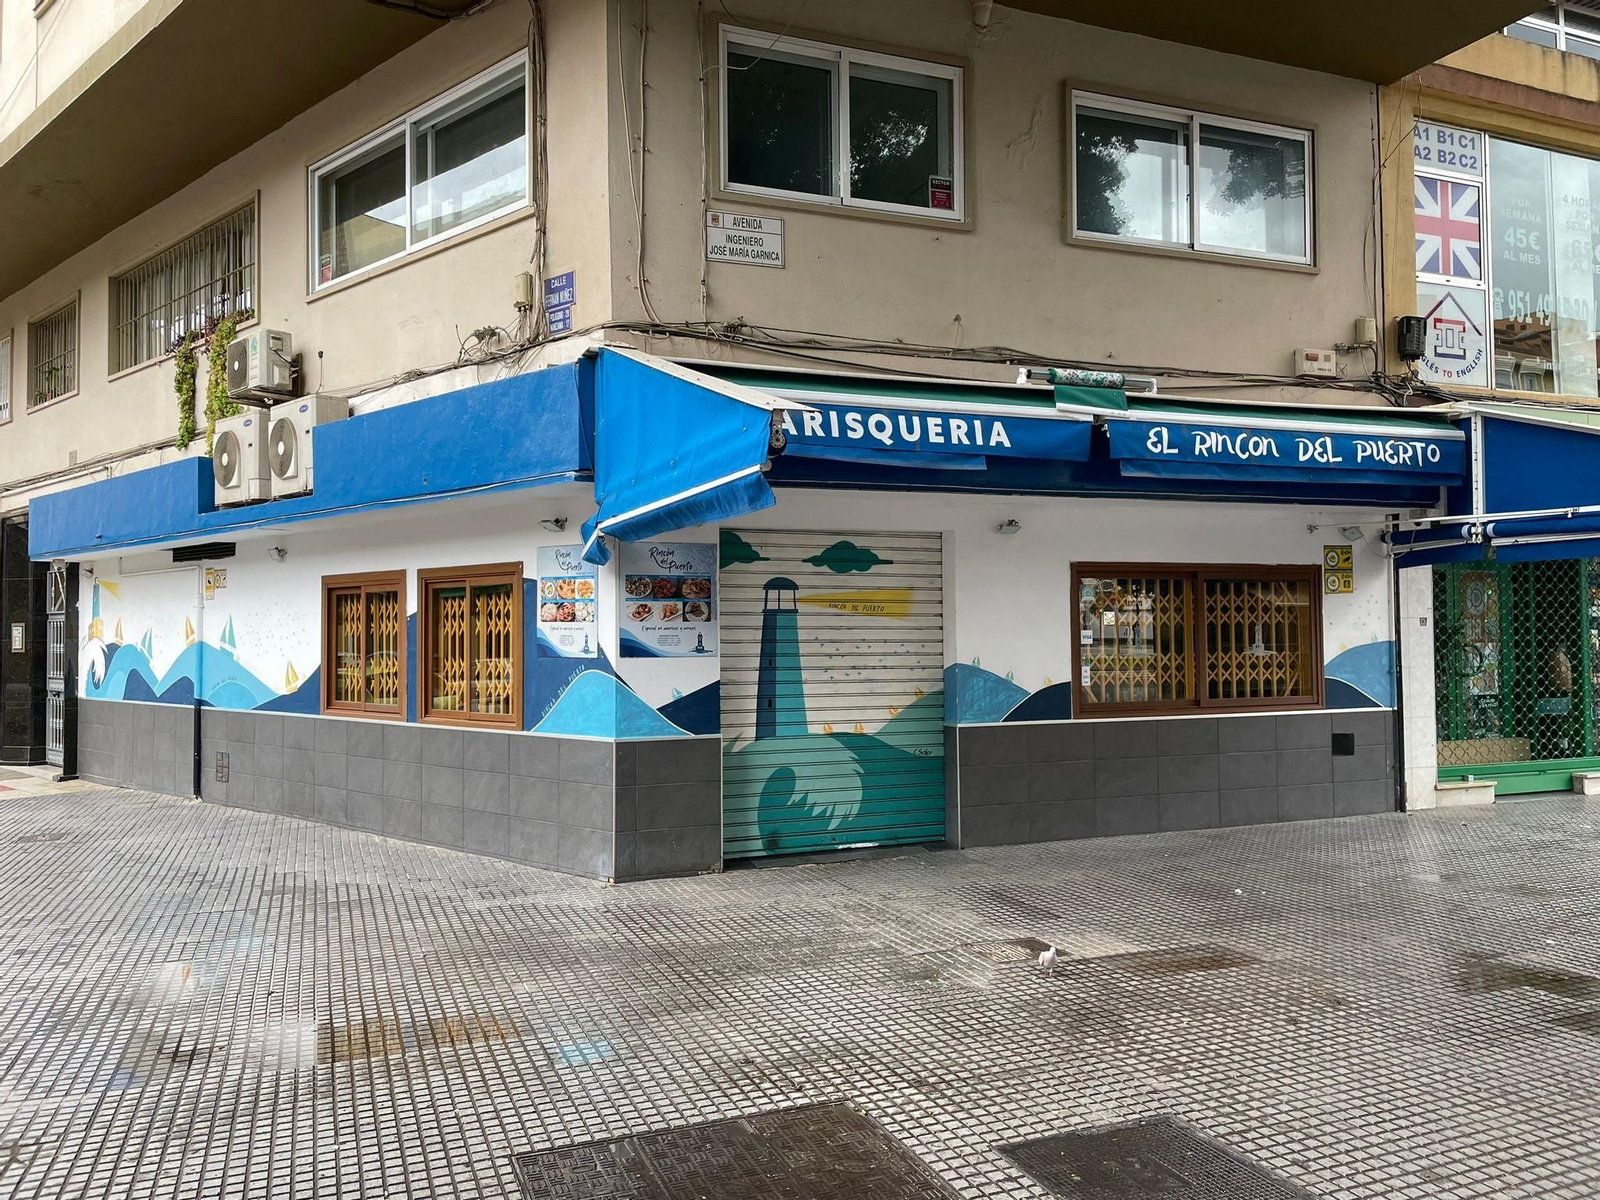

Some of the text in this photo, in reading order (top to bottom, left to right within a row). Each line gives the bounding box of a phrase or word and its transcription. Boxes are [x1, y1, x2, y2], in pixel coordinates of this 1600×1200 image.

[1414, 126, 1475, 150] A1 B1 C1
[1414, 145, 1477, 169] A2 B2 C2
[733, 217, 763, 230] AVENIDA
[726, 234, 764, 247] INGENIERO
[1503, 226, 1540, 250] 45€
[709, 245, 780, 261] JOSÉ MARÍA GARNICA
[1503, 250, 1540, 265] AL MES
[551, 276, 567, 288] CALLE
[1508, 289, 1532, 324] 951
[1536, 293, 1551, 327] 49
[1421, 348, 1483, 378] GLÉS TO ENGLISH
[782, 408, 1012, 448] ARISQUERIA
[1146, 426, 1179, 455] EL
[1294, 436, 1343, 464] DEL
[1352, 439, 1441, 467] PUERTO
[862, 604, 885, 613] PUERTO
